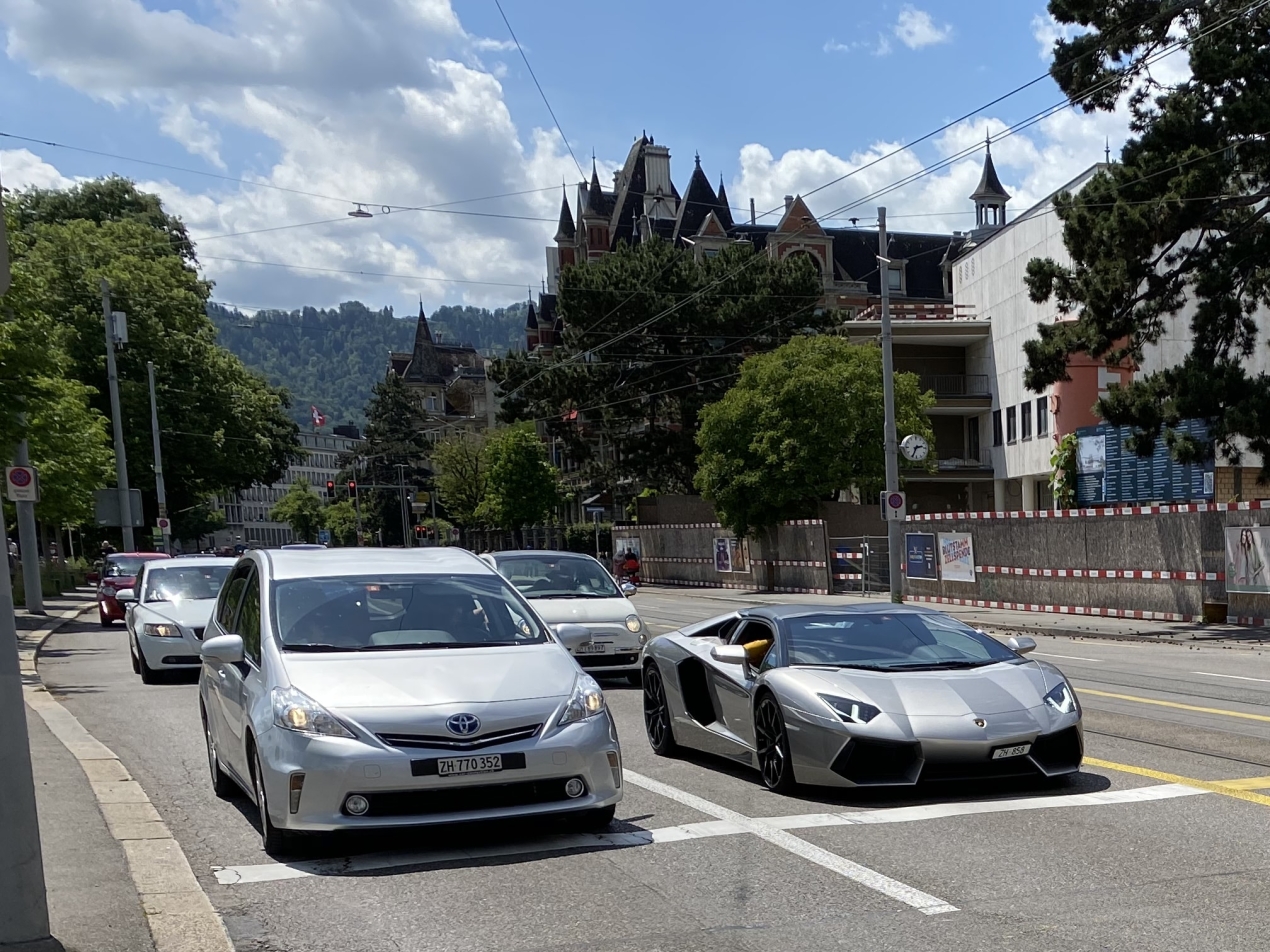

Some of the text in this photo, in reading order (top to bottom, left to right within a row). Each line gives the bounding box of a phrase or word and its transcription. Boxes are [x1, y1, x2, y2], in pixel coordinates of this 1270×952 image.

[439, 761, 454, 773] ZH
[456, 758, 478, 771] 770
[480, 756, 500, 769] 352
